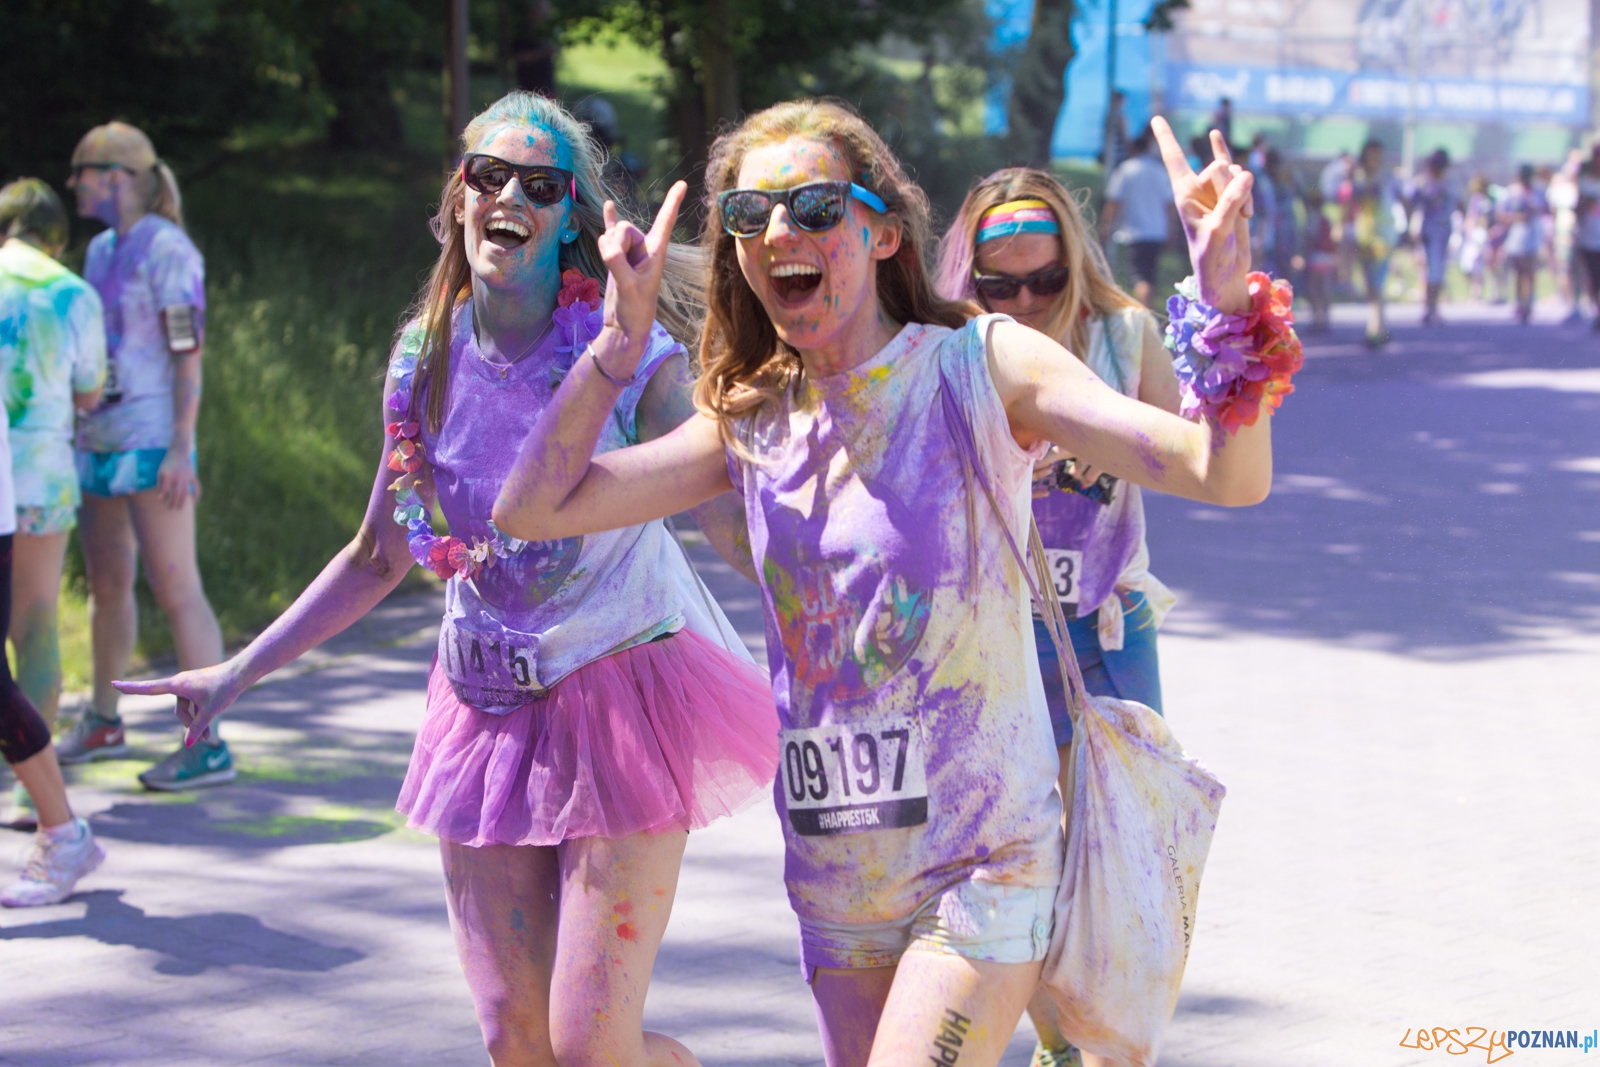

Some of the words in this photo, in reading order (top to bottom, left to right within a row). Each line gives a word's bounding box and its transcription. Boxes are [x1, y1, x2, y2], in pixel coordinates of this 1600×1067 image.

[785, 728, 909, 802] 09197
[818, 807, 881, 830] #HAPPIEST5K
[1167, 845, 1187, 912] GALERIA
